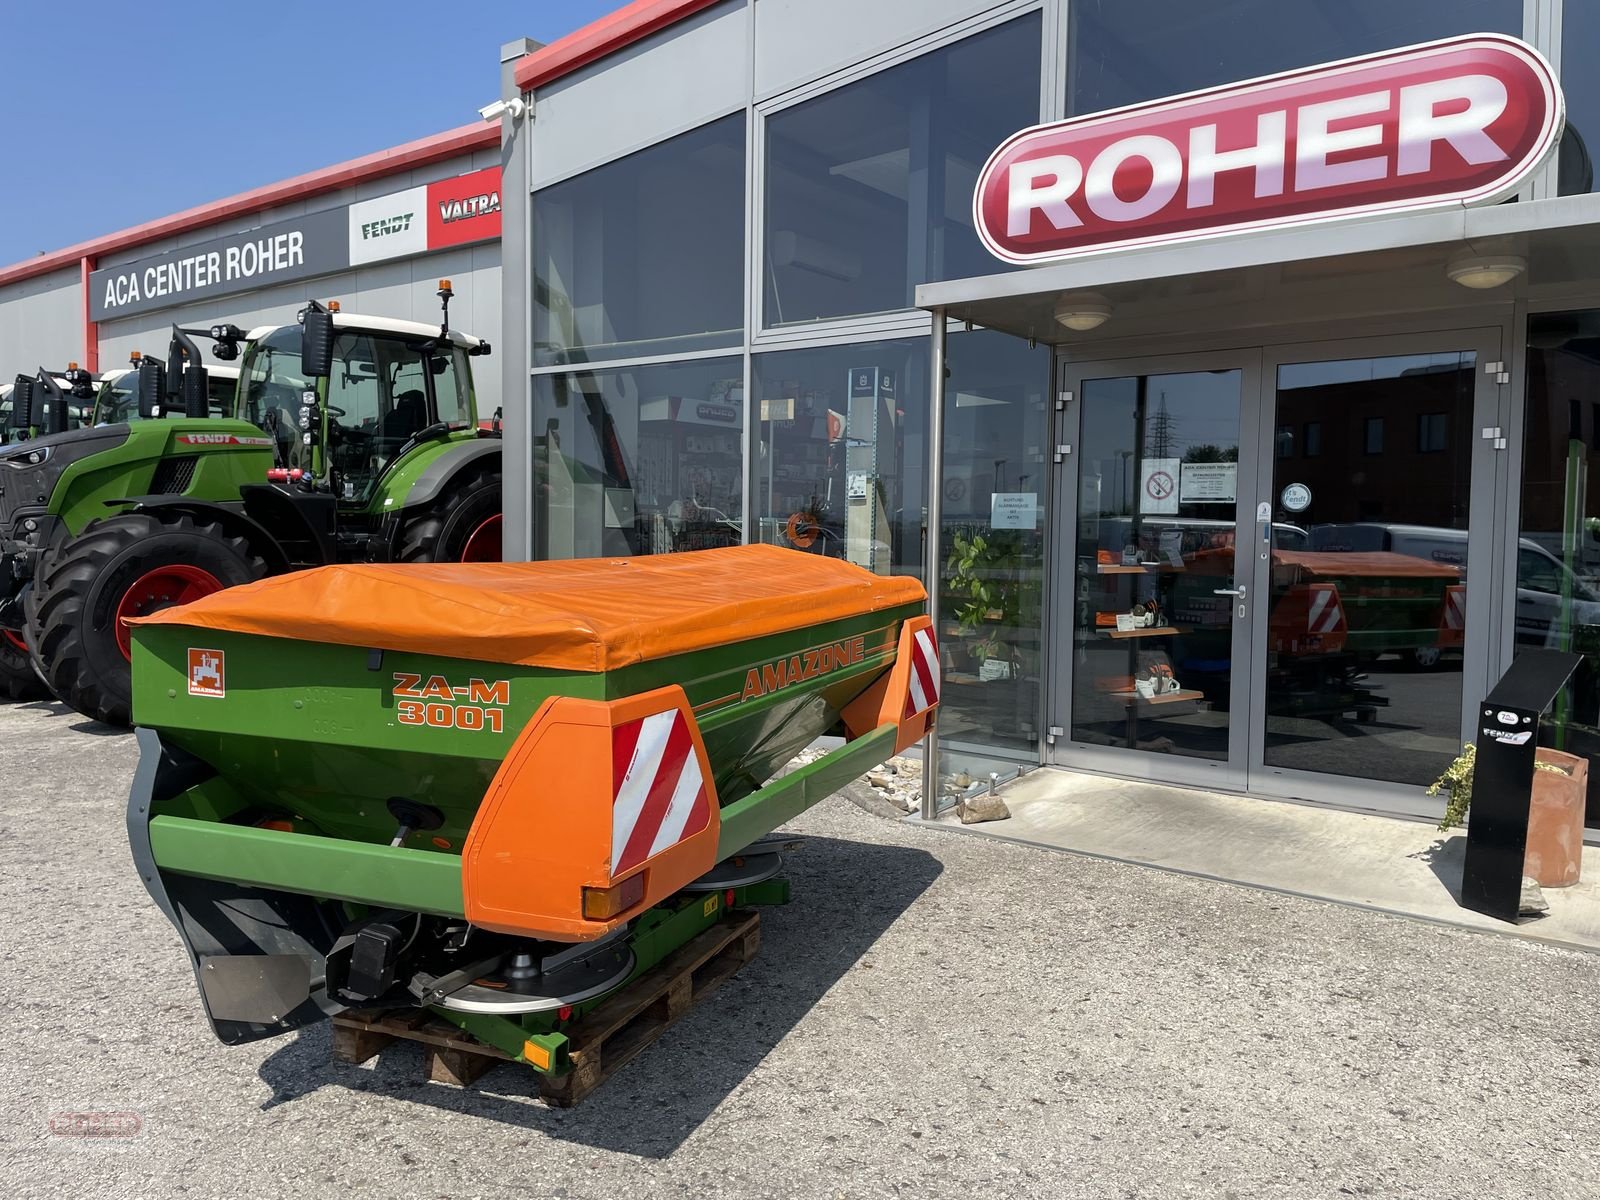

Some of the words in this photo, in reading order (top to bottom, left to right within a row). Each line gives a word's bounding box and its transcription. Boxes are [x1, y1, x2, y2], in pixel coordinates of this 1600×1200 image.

[1006, 74, 1511, 237] ROHER
[439, 191, 501, 224] VALTRA
[361, 212, 414, 240] FENDT
[104, 272, 140, 308] ACA
[144, 251, 220, 299] CENTER
[226, 231, 303, 281] ROHER
[187, 433, 232, 444] FENDT
[740, 636, 864, 702] AMAZONE
[393, 672, 509, 705] ZA-M
[398, 700, 504, 733] 3001
